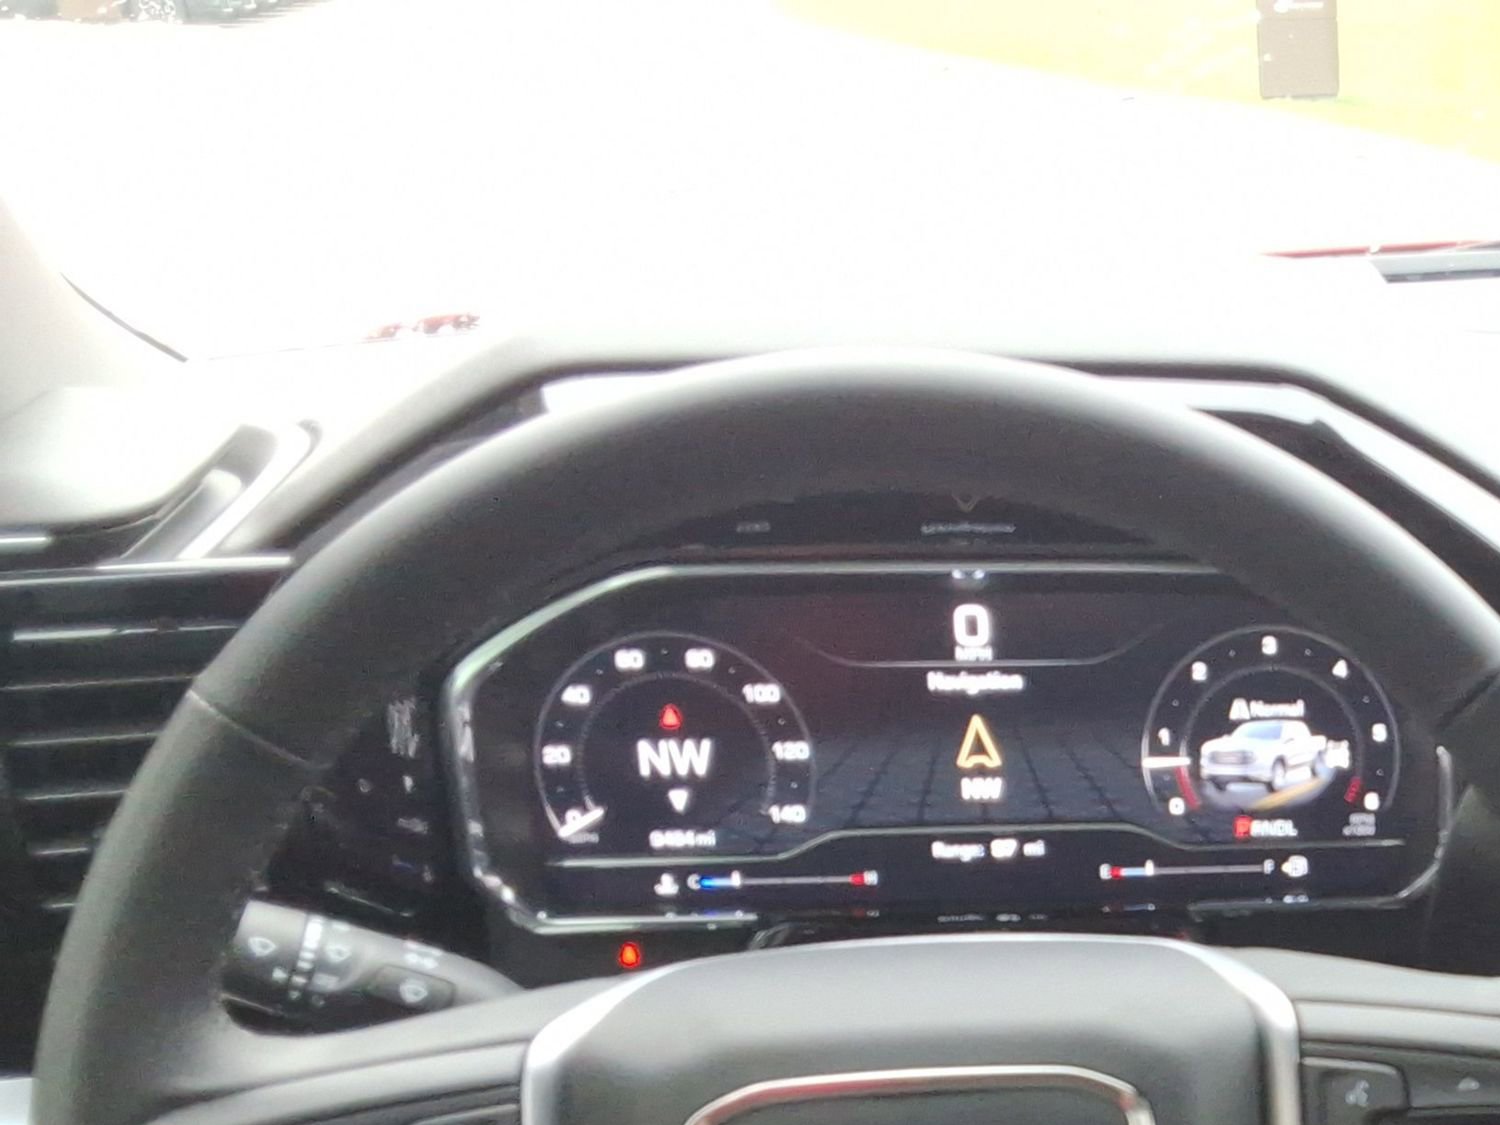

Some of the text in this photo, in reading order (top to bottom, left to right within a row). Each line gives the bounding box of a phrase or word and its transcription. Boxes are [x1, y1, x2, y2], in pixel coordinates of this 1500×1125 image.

[953, 603, 990, 647] 0
[743, 683, 781, 703] 100
[926, 671, 1025, 695] Navigation
[542, 745, 572, 765] 20
[636, 739, 712, 777] NW
[772, 741, 810, 760] 120
